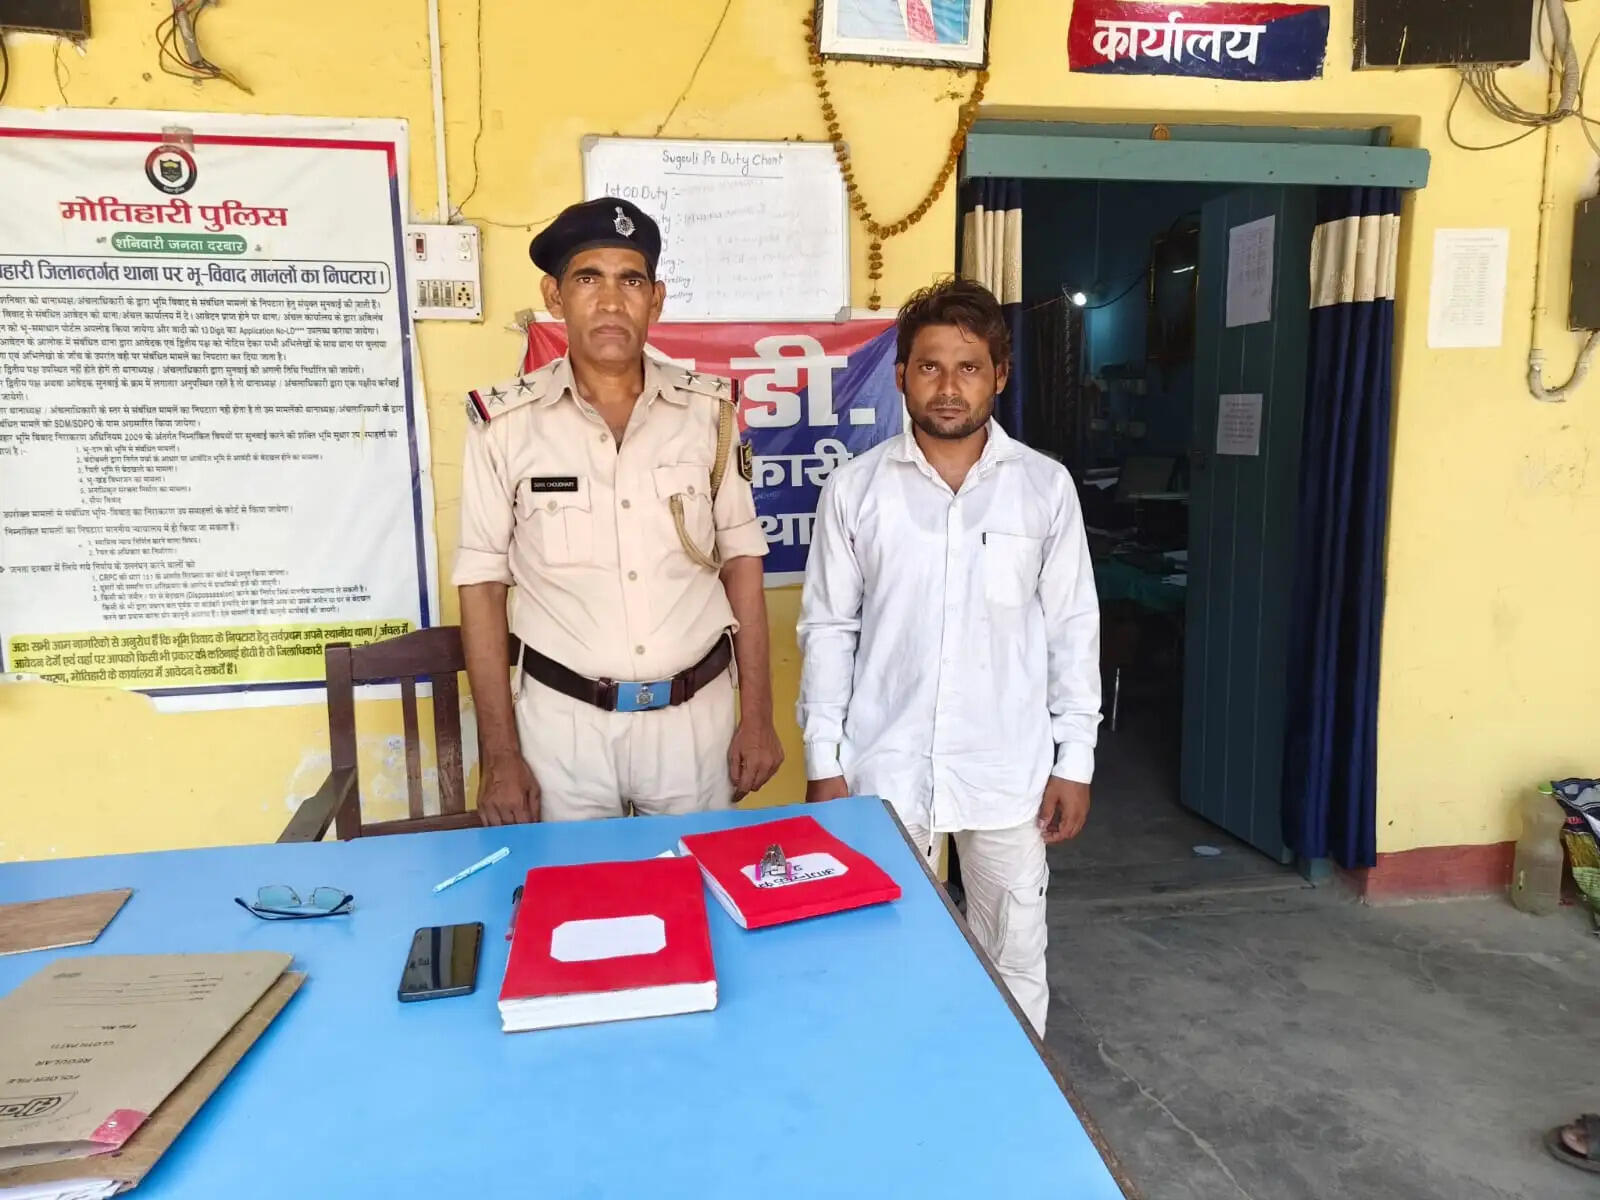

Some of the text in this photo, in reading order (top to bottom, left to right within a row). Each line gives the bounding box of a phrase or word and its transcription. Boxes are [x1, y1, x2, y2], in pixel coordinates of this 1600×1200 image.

[1093, 11, 1266, 65] कार्यालय
[721, 151, 749, 177] Duty
[642, 186, 668, 210] Duty
[59, 196, 289, 232] मोतिहारी पुलिस
[115, 236, 244, 253] शनिवारी जनता दरबार
[38, 259, 119, 282] जिलान्तर्गत
[123, 266, 159, 282] थाना
[163, 267, 183, 282] पर
[300, 269, 320, 284] का
[240, 328, 275, 336] Application
[54, 419, 94, 428] SDM/SDPO
[31, 638, 50, 651] सभी
[52, 641, 72, 650] आम
[121, 634, 150, 650] अनुरोध
[190, 631, 214, 644] विवाद
[14, 655, 44, 668] आवेदन
[71, 669, 107, 681] मोतिहारी
[118, 666, 154, 679] कार्यालय
